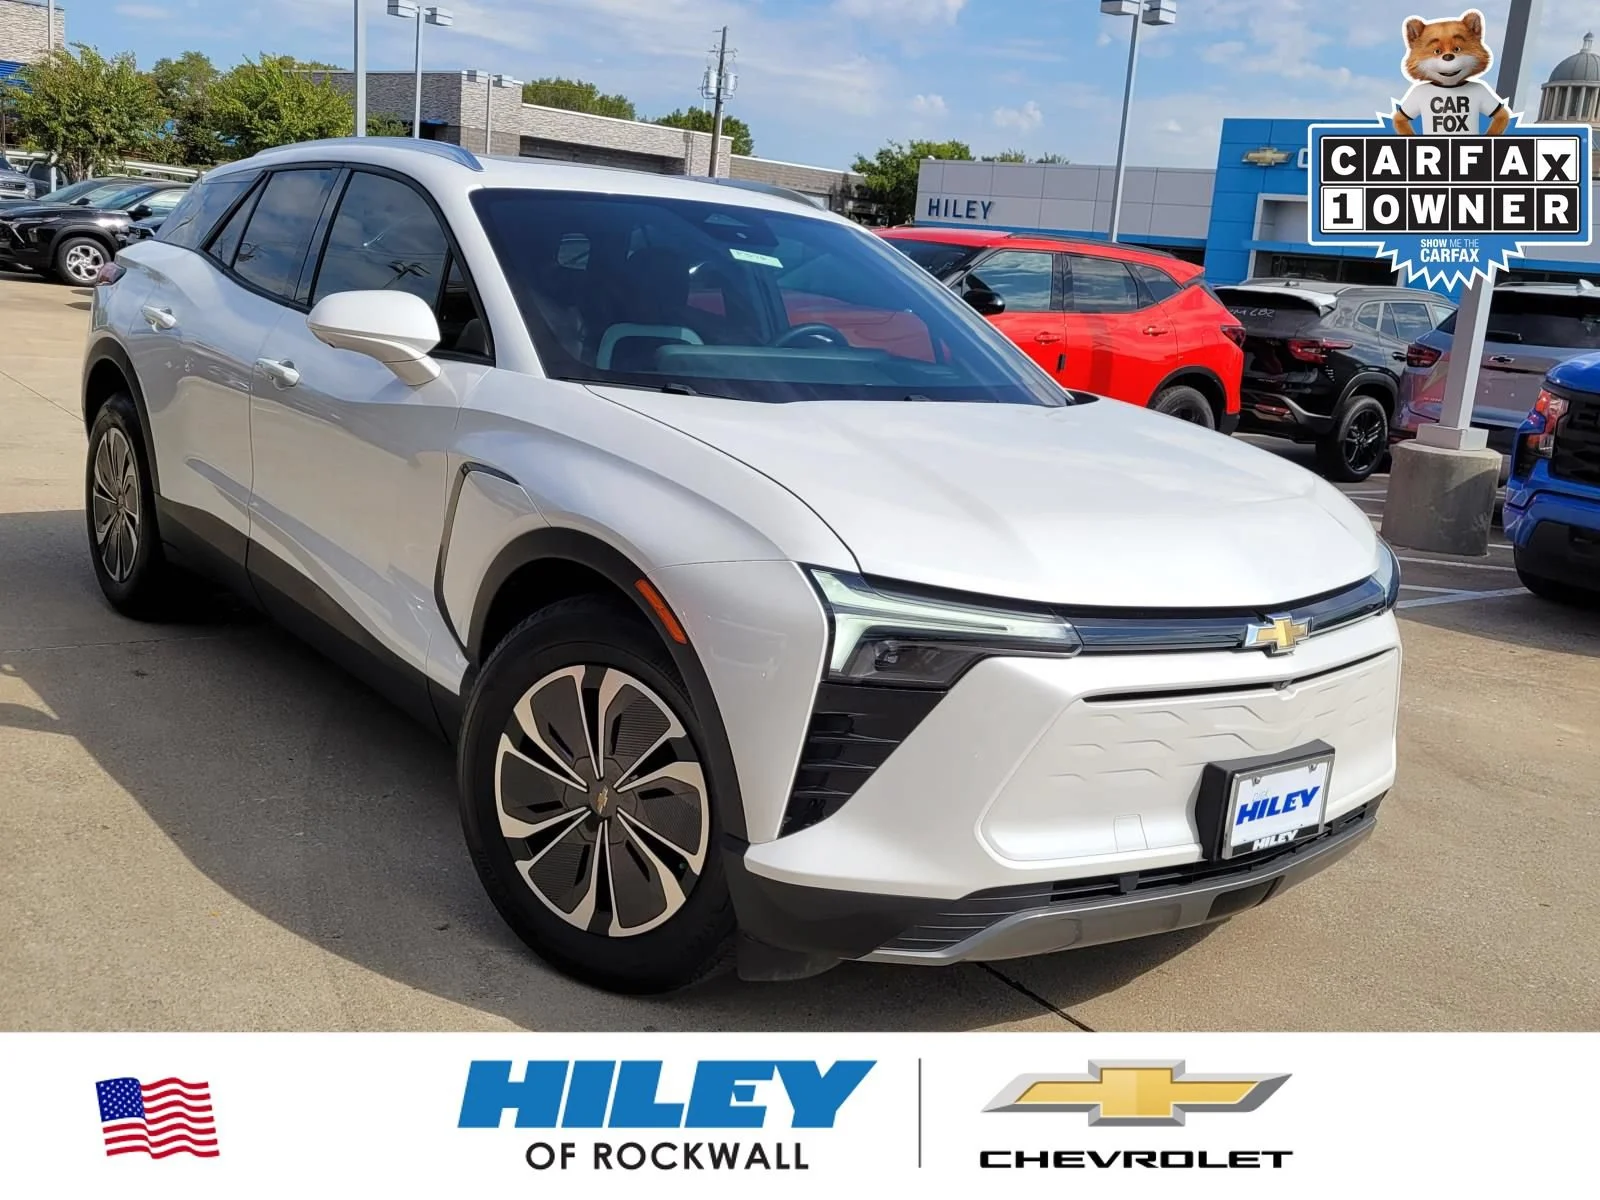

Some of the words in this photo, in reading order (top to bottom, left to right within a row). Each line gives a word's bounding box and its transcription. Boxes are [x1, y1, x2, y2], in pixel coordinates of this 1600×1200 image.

[928, 198, 992, 220] HILEY
[1236, 785, 1321, 826] HILEY
[1252, 829, 1299, 851] HILEY
